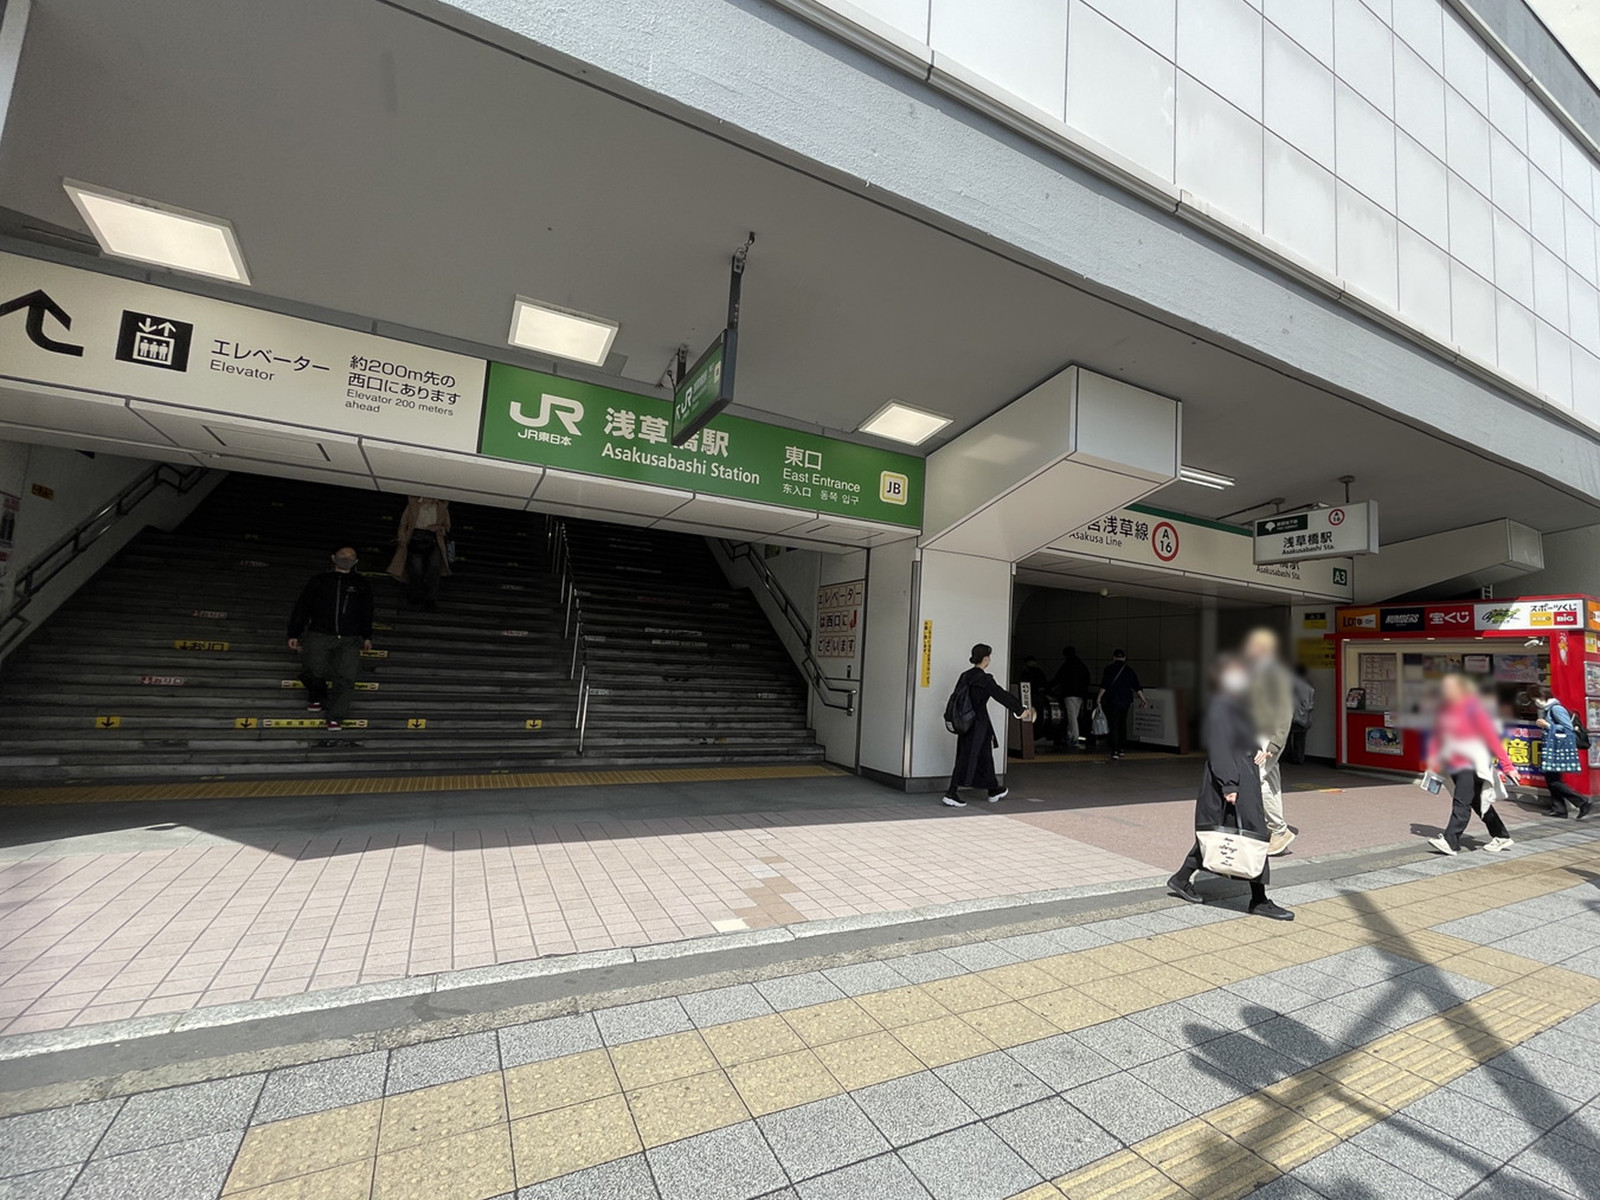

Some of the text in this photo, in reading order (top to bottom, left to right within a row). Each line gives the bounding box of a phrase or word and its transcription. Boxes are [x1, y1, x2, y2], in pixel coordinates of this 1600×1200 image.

[211, 339, 330, 371] エレベーター
[210, 359, 275, 380] Elevator
[349, 355, 456, 388] 約200m先の
[348, 372, 461, 405] 西口にあります
[345, 400, 381, 413] ahead
[346, 388, 454, 416] Elevator 200 meters
[509, 393, 585, 436] JR
[517, 428, 572, 446] JR東日本
[602, 443, 760, 484] Asakusabashi Station
[784, 446, 822, 470] 東口
[783, 468, 860, 493] East Entrance
[887, 481, 901, 495] JB
[782, 483, 812, 498] 东入口
[841, 493, 860, 506] 입구
[1106, 536, 1123, 547] Line
[1162, 529, 1170, 540] A
[1283, 531, 1333, 548] 浅草橋駅
[1160, 541, 1172, 553] 16
[1282, 546, 1322, 555] Asakusabashi
[1256, 566, 1292, 579] Asakusabashi
[1335, 571, 1346, 583] A3
[1530, 603, 1577, 612] スポーツくじ
[1429, 611, 1470, 625] 宝くじ
